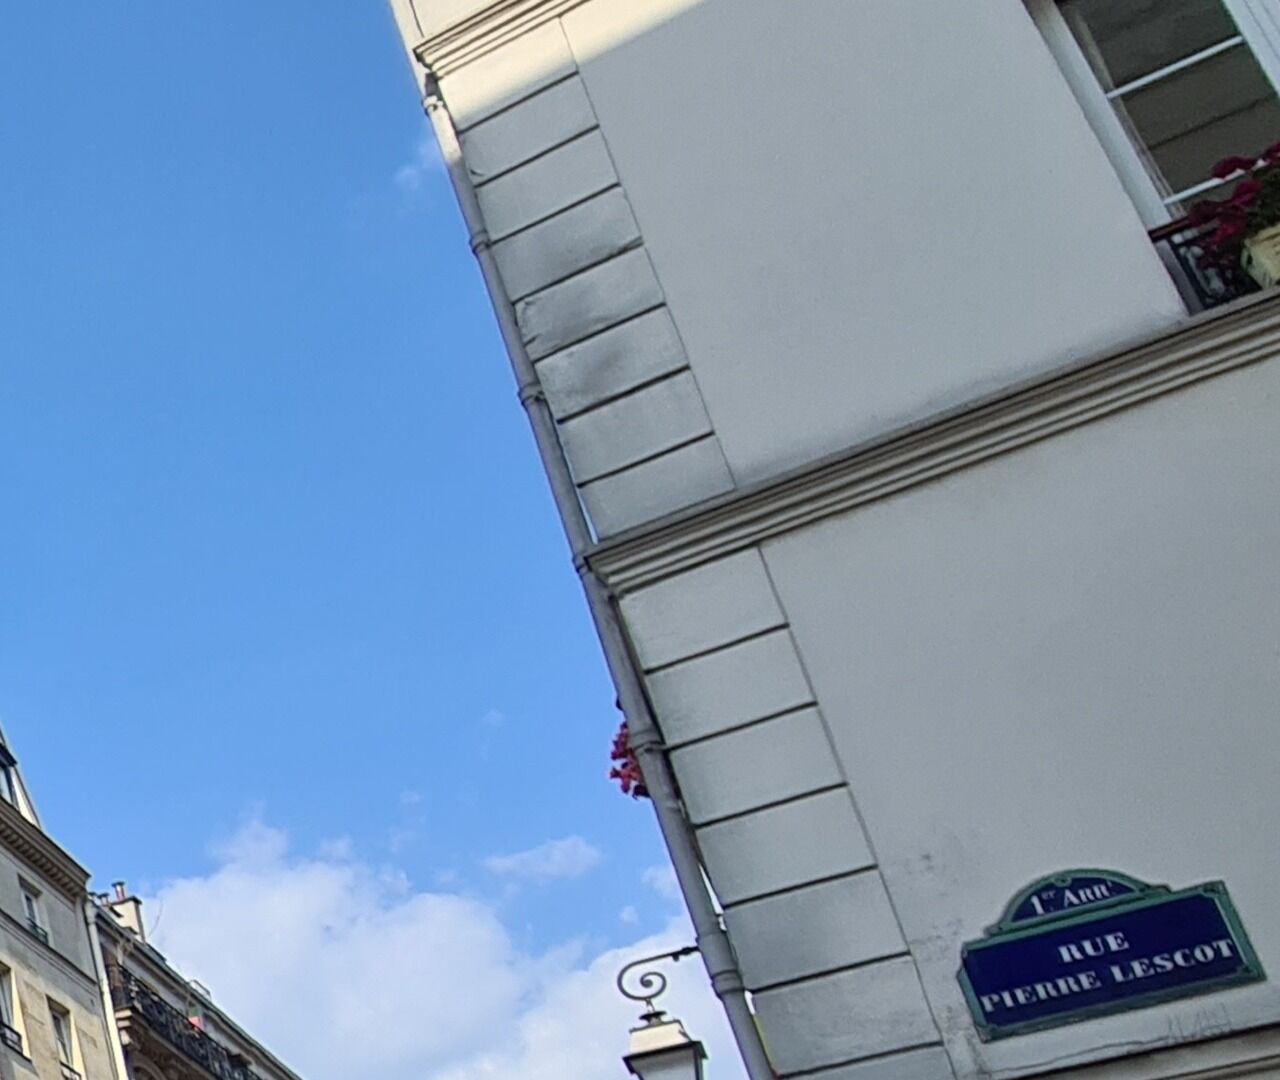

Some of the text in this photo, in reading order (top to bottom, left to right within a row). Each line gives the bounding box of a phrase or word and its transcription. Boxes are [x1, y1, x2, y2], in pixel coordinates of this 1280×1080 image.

[1057, 931, 1130, 964] RUE
[980, 938, 1236, 1013] PIERRE LESCOT
